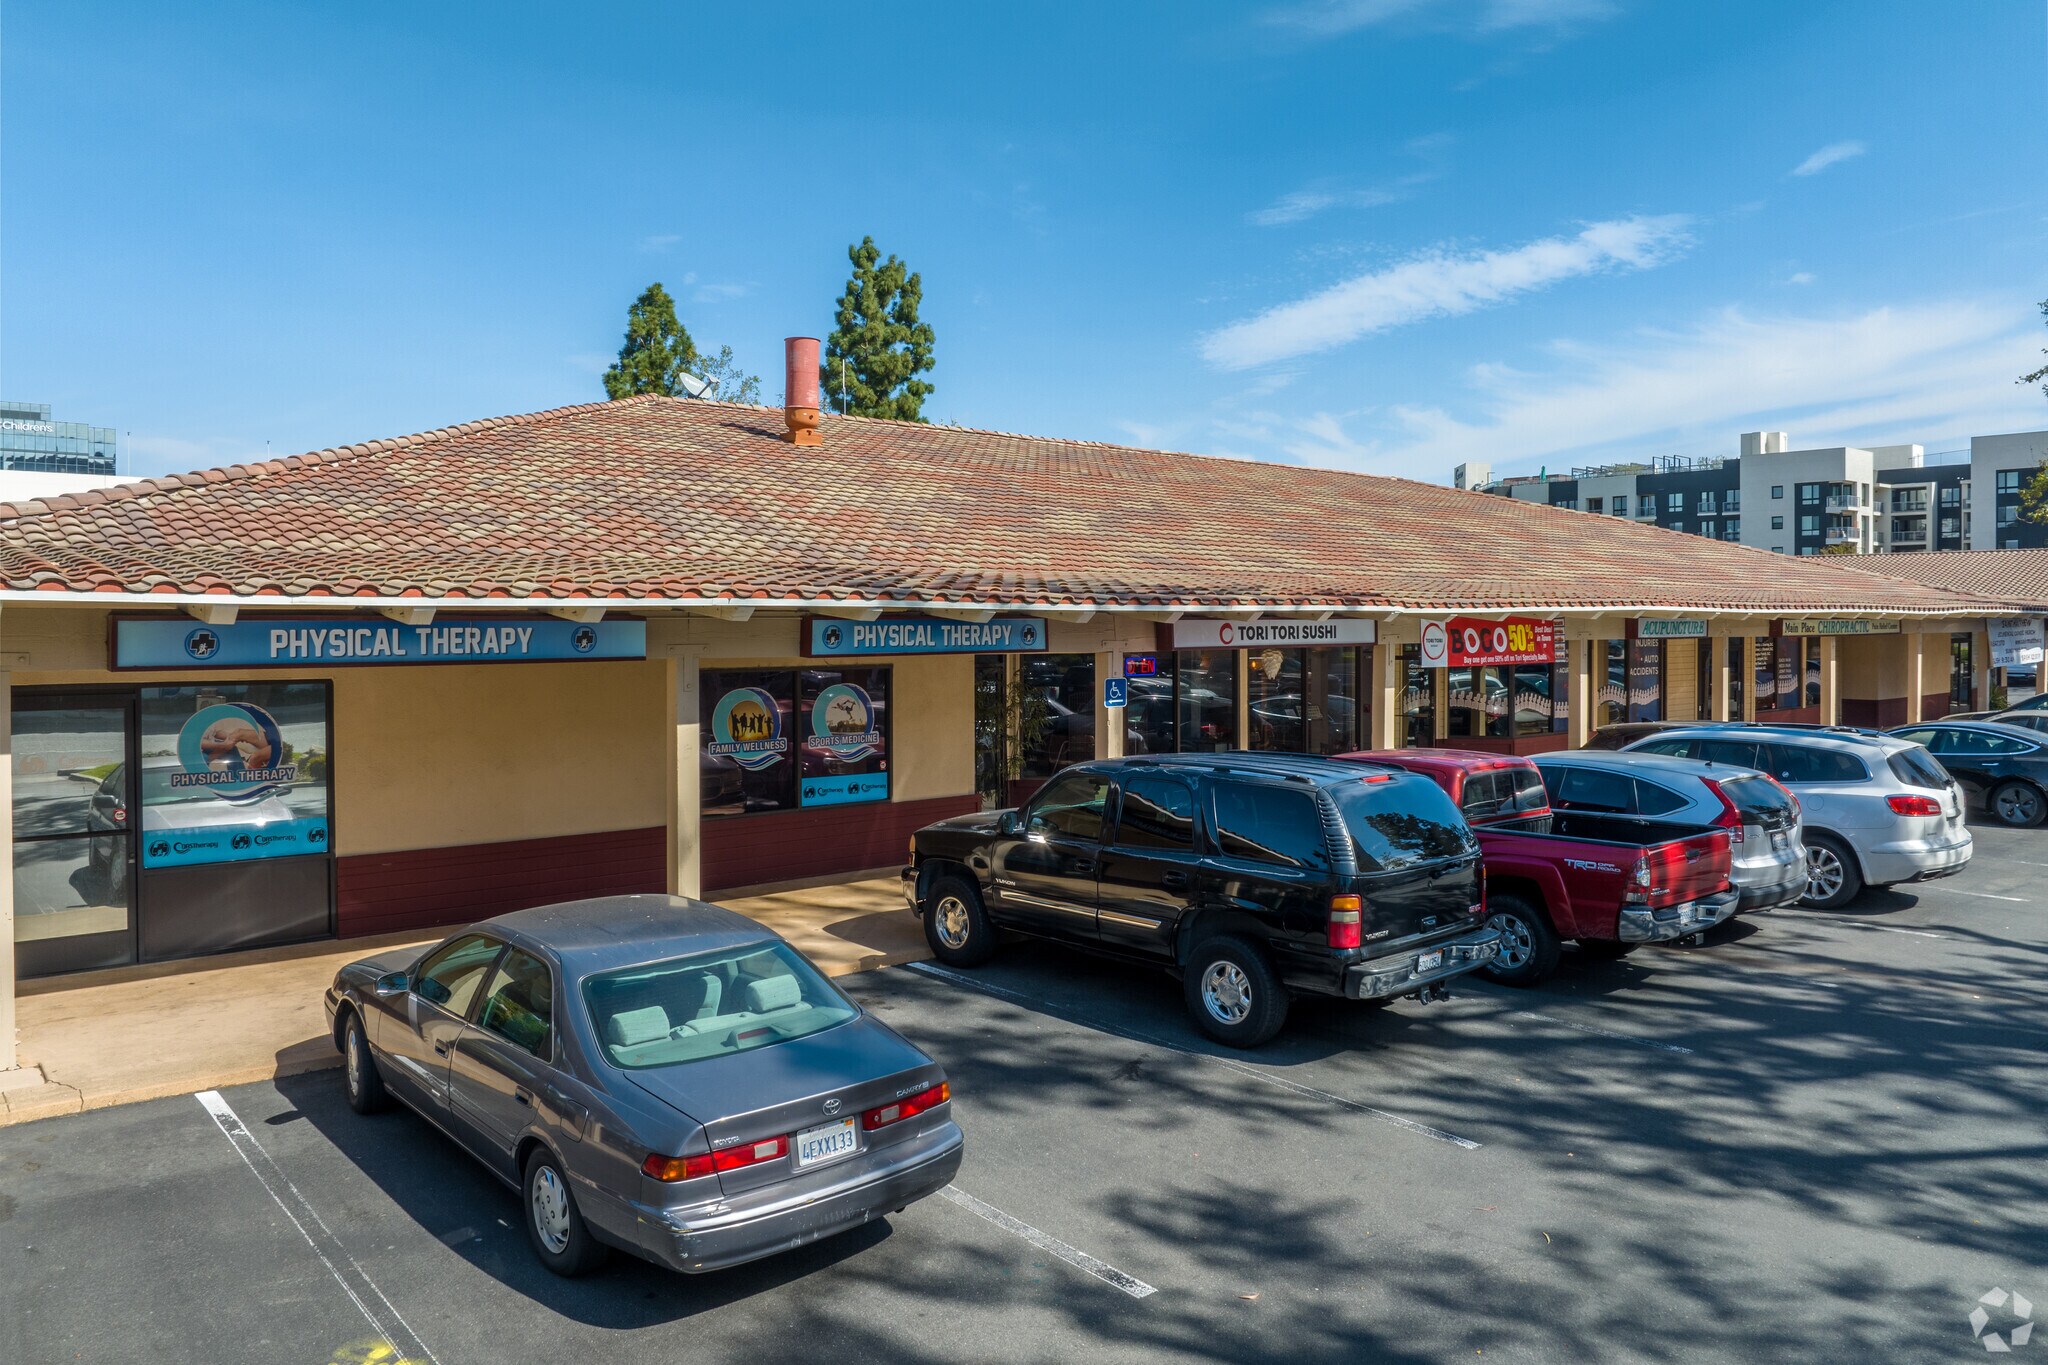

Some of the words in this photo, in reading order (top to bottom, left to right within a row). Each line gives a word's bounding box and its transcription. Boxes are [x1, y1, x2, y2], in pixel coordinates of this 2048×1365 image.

[2, 421, 53, 432] Children's
[1238, 626, 1268, 640] TORI
[1272, 626, 1299, 640] TORI
[1302, 625, 1336, 639] SUSHI
[1642, 621, 1705, 635] ACUPUNCTURE
[1785, 623, 1798, 633] Main
[1801, 622, 1815, 632] Place
[1818, 621, 1869, 633] CHIROPRACTIC
[270, 628, 406, 658] PHYSICAL
[416, 627, 532, 655] THERAPY
[854, 624, 935, 648] PHYSICAL
[941, 624, 1012, 646] THERAPY
[1451, 627, 1508, 654] BOGO
[1508, 624, 1534, 652] 50%
[1635, 639, 1658, 647] INJURIES
[1464, 656, 1472, 664] Buy
[1644, 655, 1658, 663] AUTO
[1127, 659, 1154, 674] OEN
[1630, 667, 1658, 676] ACCIDENTS
[711, 743, 741, 754] FAMILY
[743, 740, 785, 752] WELLNESS
[810, 735, 839, 747] SPORTS
[841, 733, 878, 744] MEDICINE
[172, 771, 235, 787] PHYSICAL
[239, 768, 295, 782] THERAPY
[1564, 858, 1597, 870] TRD
[995, 878, 1016, 886] YUKON
[897, 1083, 922, 1097] CAMRY
[714, 1136, 739, 1146] TOYOTA
[803, 1130, 853, 1160] 4EXX133
